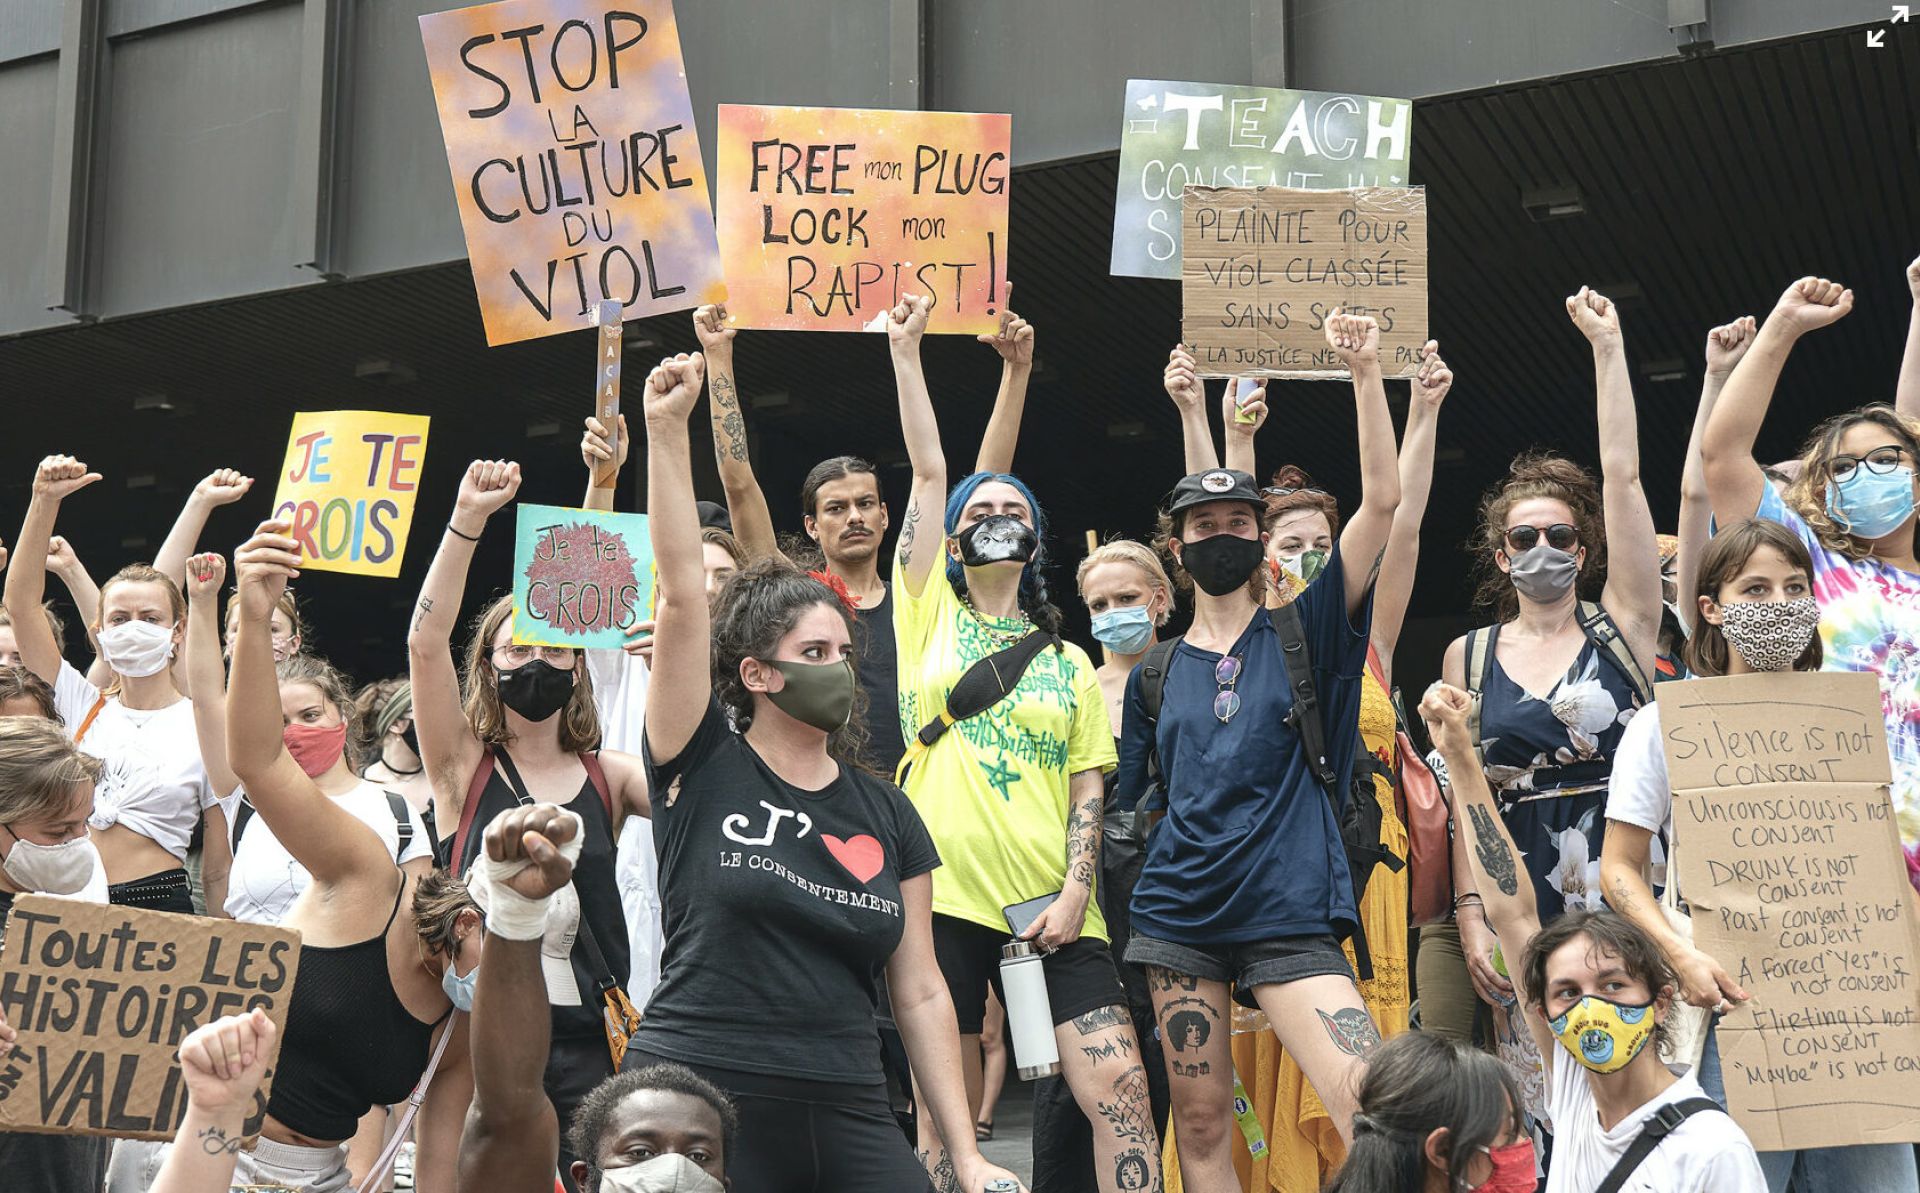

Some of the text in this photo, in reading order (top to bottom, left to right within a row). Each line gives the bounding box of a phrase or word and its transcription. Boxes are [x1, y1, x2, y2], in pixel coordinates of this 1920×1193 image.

[459, 10, 648, 119] STOP
[549, 104, 600, 143] LA
[1163, 91, 1409, 160] TEACH
[471, 124, 693, 224] CULTURE
[749, 138, 1006, 196] FREE mon PLUG
[562, 209, 614, 247] DU
[762, 204, 946, 249] LOCK mon
[1338, 208, 1410, 243] POUR
[509, 240, 687, 322] VIOL
[1286, 250, 1408, 286] CLASSÉE
[1221, 302, 1292, 330] SANS
[1208, 347, 1228, 364] LA
[289, 431, 421, 492] JE TE
[536, 524, 617, 562] Je te
[527, 582, 638, 629] CROIS
[1669, 721, 1873, 760] Silence is not
[722, 800, 813, 846] J'
[1688, 795, 1836, 823] Unconscious
[1867, 798, 1890, 822] not
[720, 851, 899, 917] LE CONSENTEMENT
[1706, 856, 1799, 887] DRUNK
[1827, 855, 1859, 877] NOT
[1720, 906, 1770, 932] Past
[1855, 902, 1870, 924] is
[1875, 899, 1902, 922] not
[199, 936, 291, 993] LES
[1738, 956, 1754, 986] A
[1762, 952, 1825, 982] forced
[1883, 953, 1904, 975] is
[1791, 973, 1831, 995] not
[1882, 1005, 1914, 1028] not
[1828, 1060, 1845, 1080] is
[1855, 1051, 1887, 1076] not
